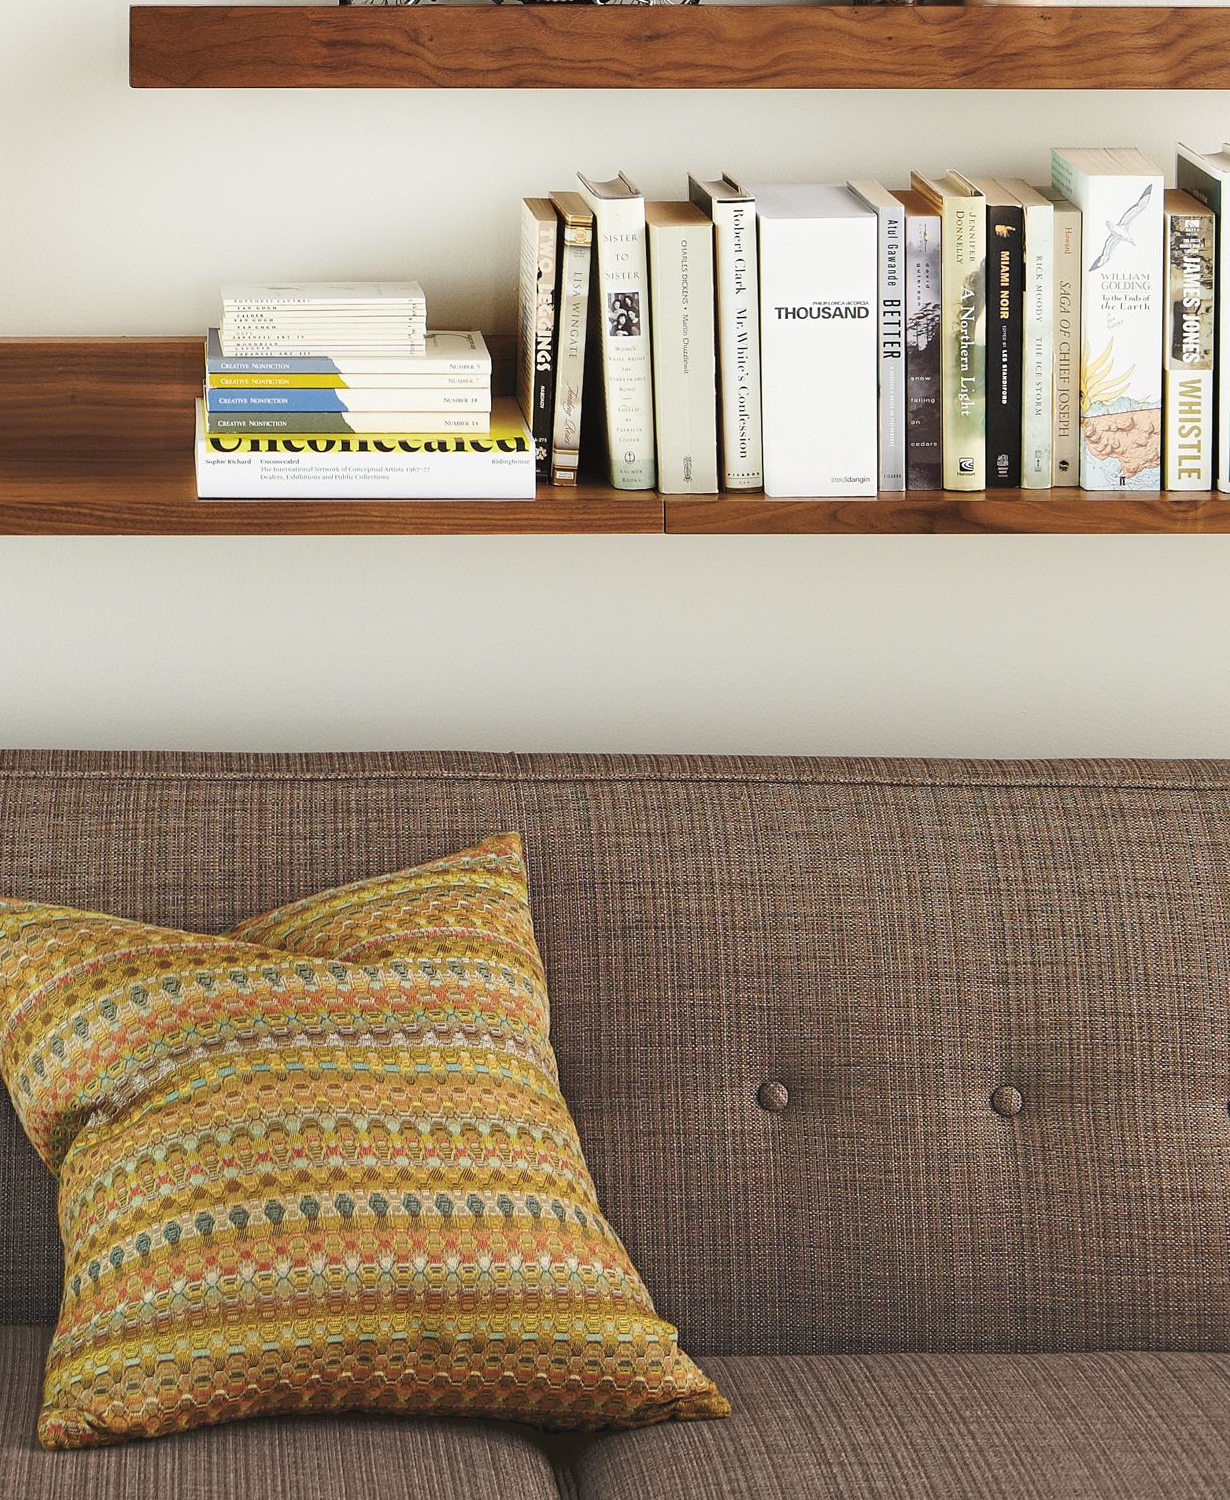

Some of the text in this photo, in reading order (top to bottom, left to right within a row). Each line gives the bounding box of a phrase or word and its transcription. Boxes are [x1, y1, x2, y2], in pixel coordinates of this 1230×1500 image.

[603, 234, 637, 242] SISTER
[616, 253, 629, 261] TO
[731, 209, 747, 295] Robert Clark
[887, 220, 899, 286] Atul Gawande
[956, 210, 964, 264] DONNELLY
[969, 212, 977, 262] JENNIFER
[1064, 227, 1073, 254] Howard
[572, 272, 583, 299] LISA
[605, 271, 640, 279] SISTER
[680, 240, 689, 304] CHARLES DICKENS
[1000, 251, 1010, 319] MIAMI NOIR
[1035, 256, 1043, 322] RICK MOODY
[1101, 281, 1150, 290] GOLDING
[1182, 257, 1201, 309] JAMES
[568, 303, 581, 359] WINGATE
[682, 315, 690, 335] Martin
[774, 306, 869, 320] THOUSAND
[882, 299, 901, 359] BETTER
[1182, 314, 1201, 362] JONES
[959, 286, 976, 416] A Northern Light
[1035, 338, 1043, 416] THE ICE STORM
[1058, 281, 1071, 437] SAGA OF CHIEF JOSEPH
[735, 308, 751, 458] Mr. White's Confession
[1178, 378, 1202, 480] WHISTLE
